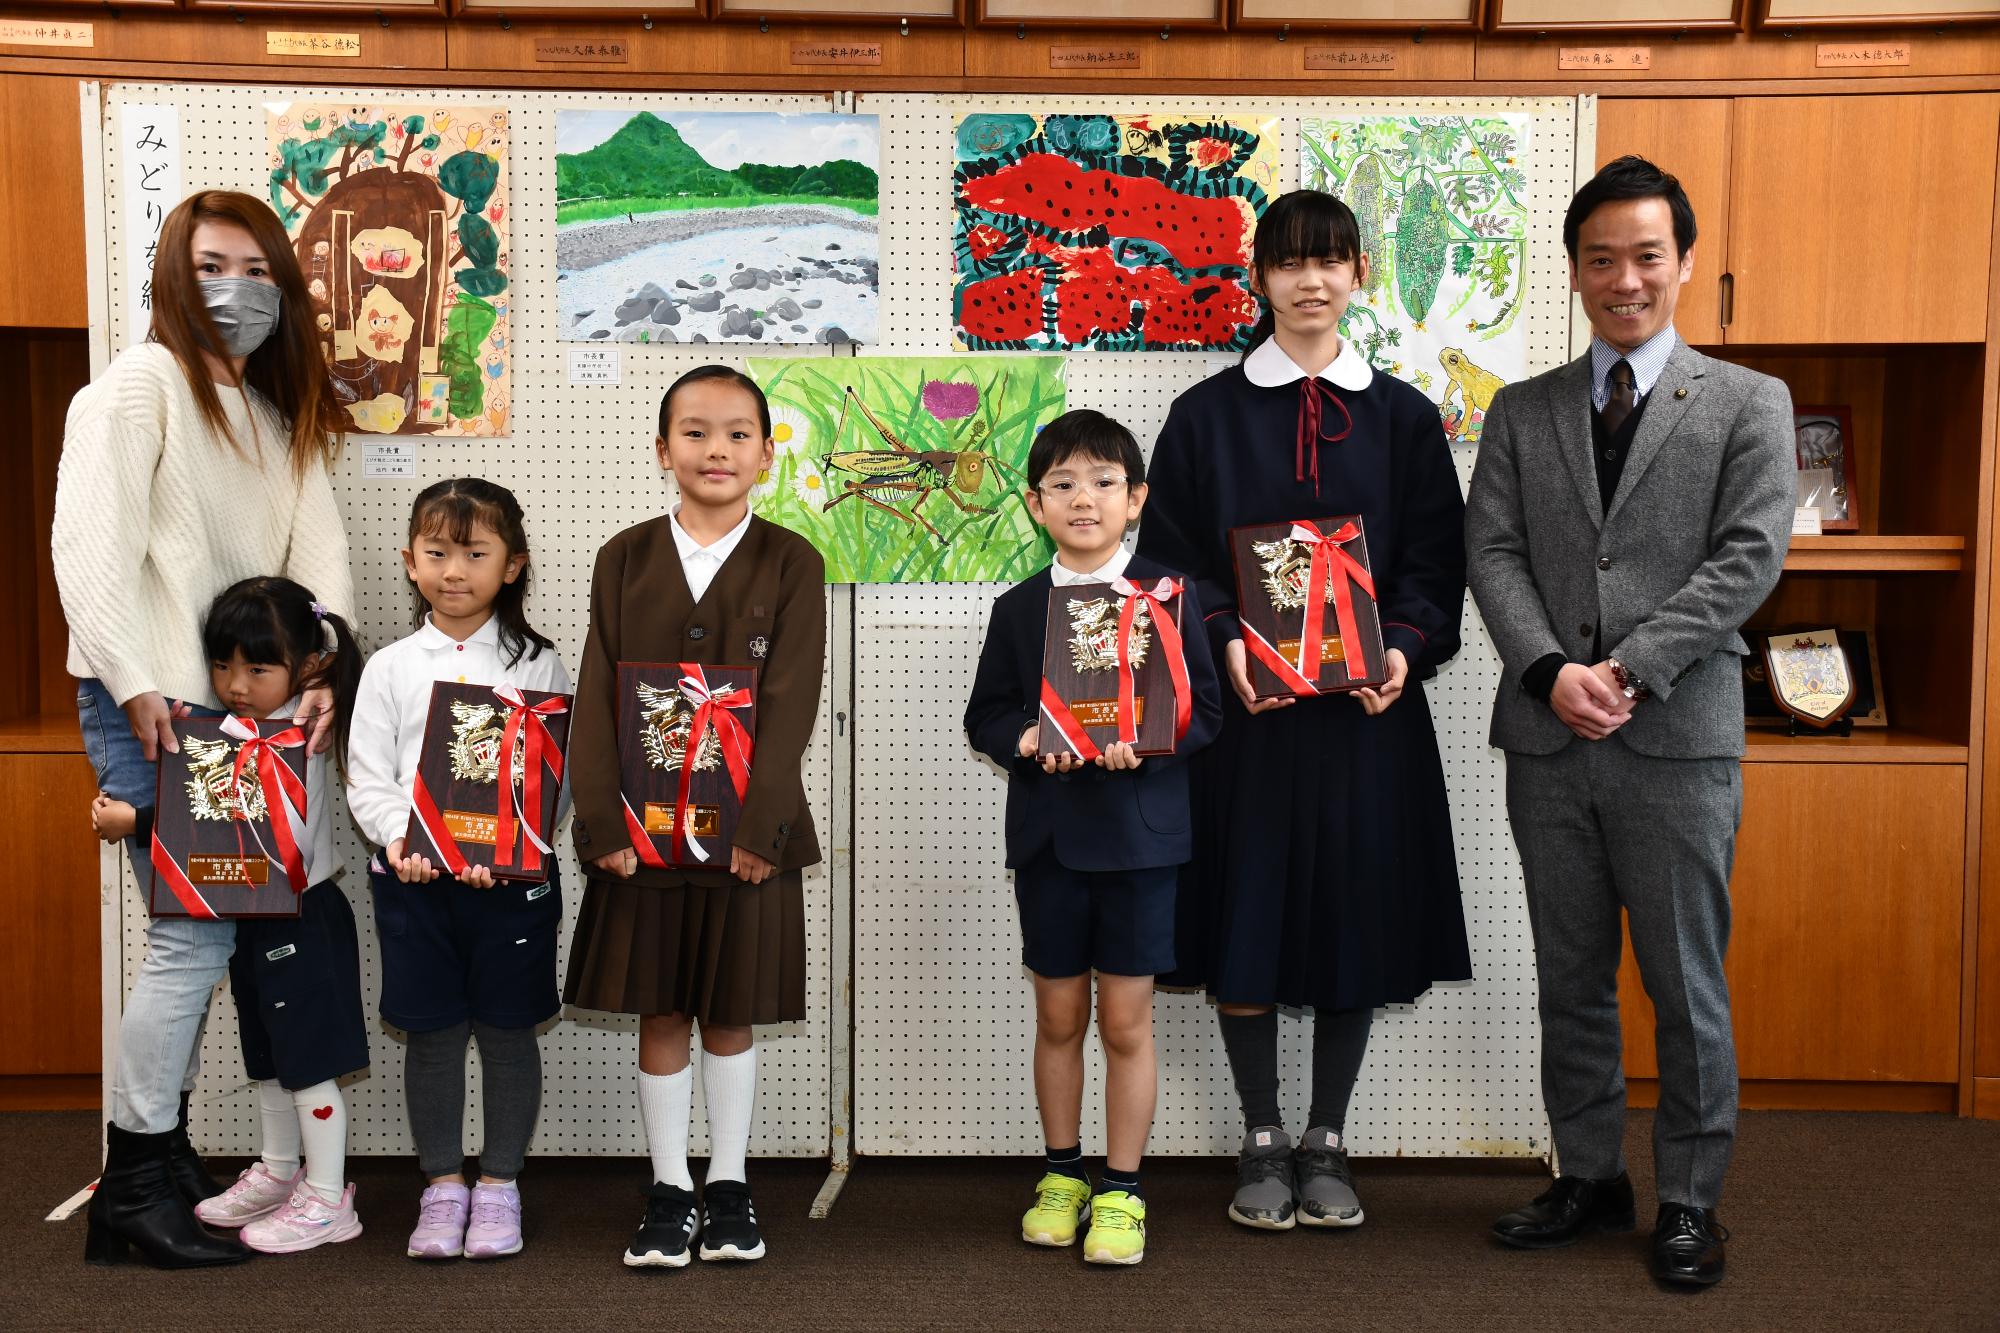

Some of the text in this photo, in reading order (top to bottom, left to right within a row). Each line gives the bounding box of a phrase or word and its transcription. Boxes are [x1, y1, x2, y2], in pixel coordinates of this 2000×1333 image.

[377, 447, 399, 455] 市長賞
[465, 821, 495, 831] 市長賞
[212, 863, 244, 871] 市長賞
